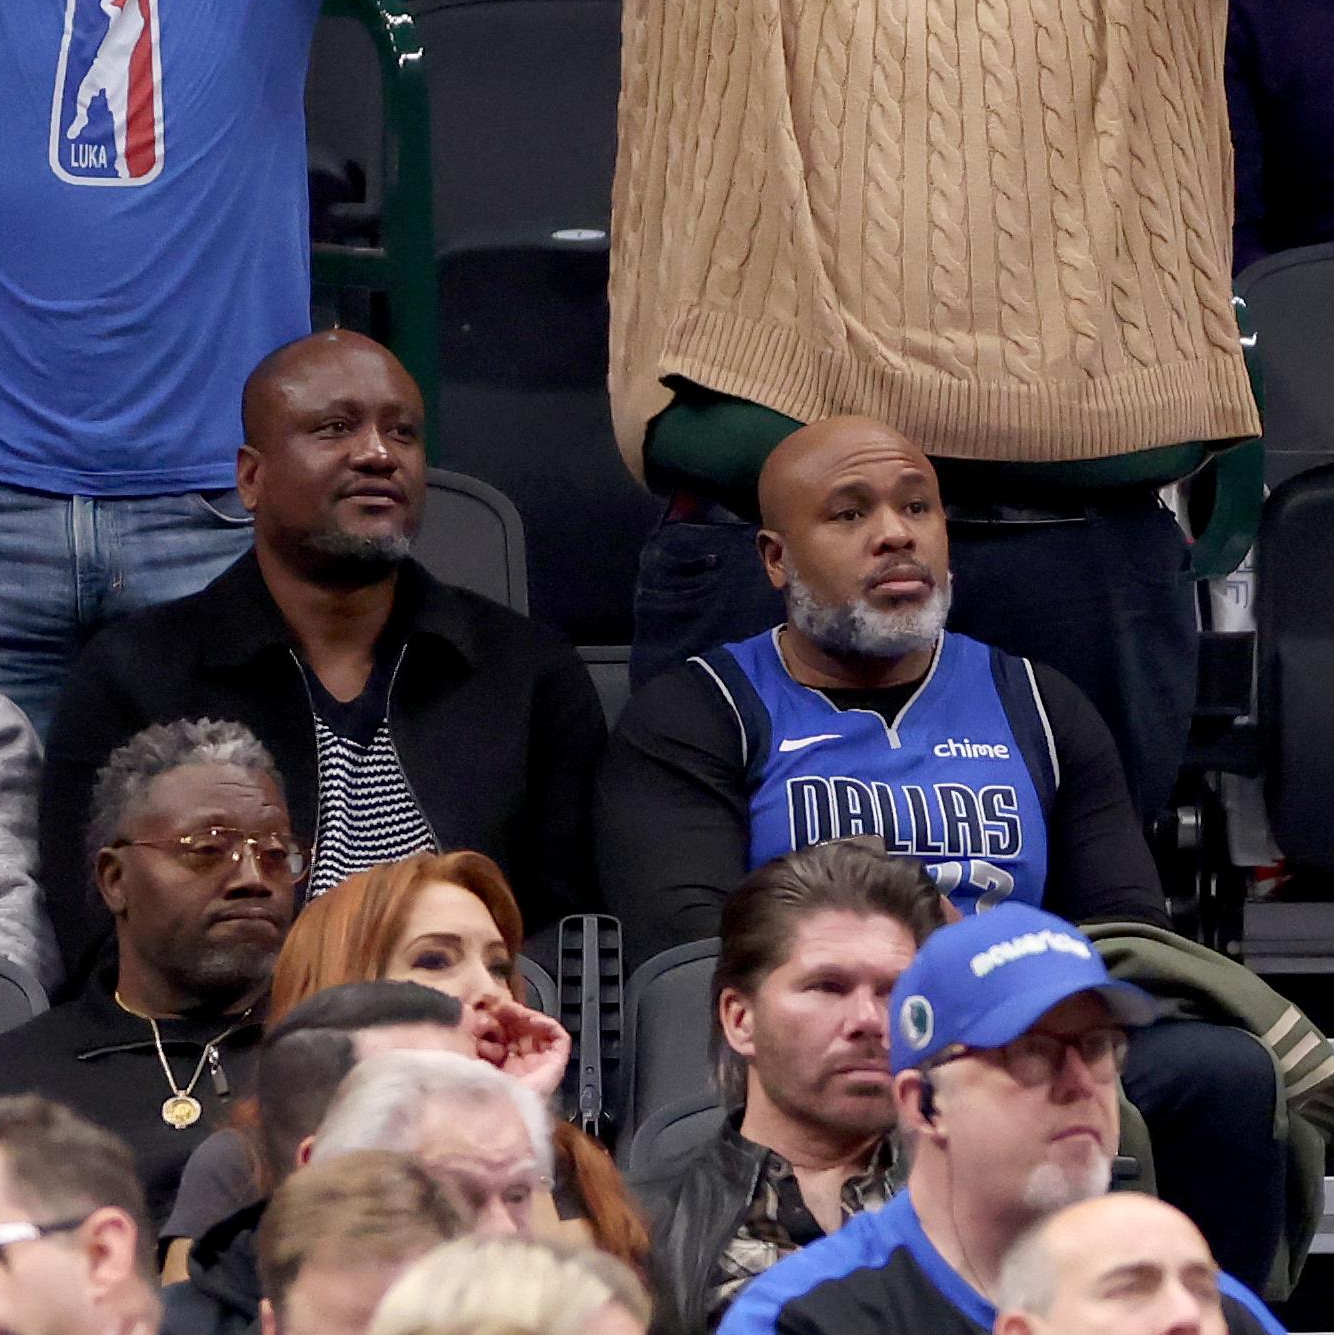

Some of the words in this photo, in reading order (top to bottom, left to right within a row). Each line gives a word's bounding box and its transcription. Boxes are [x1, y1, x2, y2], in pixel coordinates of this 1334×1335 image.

[71, 143, 107, 168] LUKA
[934, 738, 1010, 759] chime
[787, 775, 1022, 858] DALLAS
